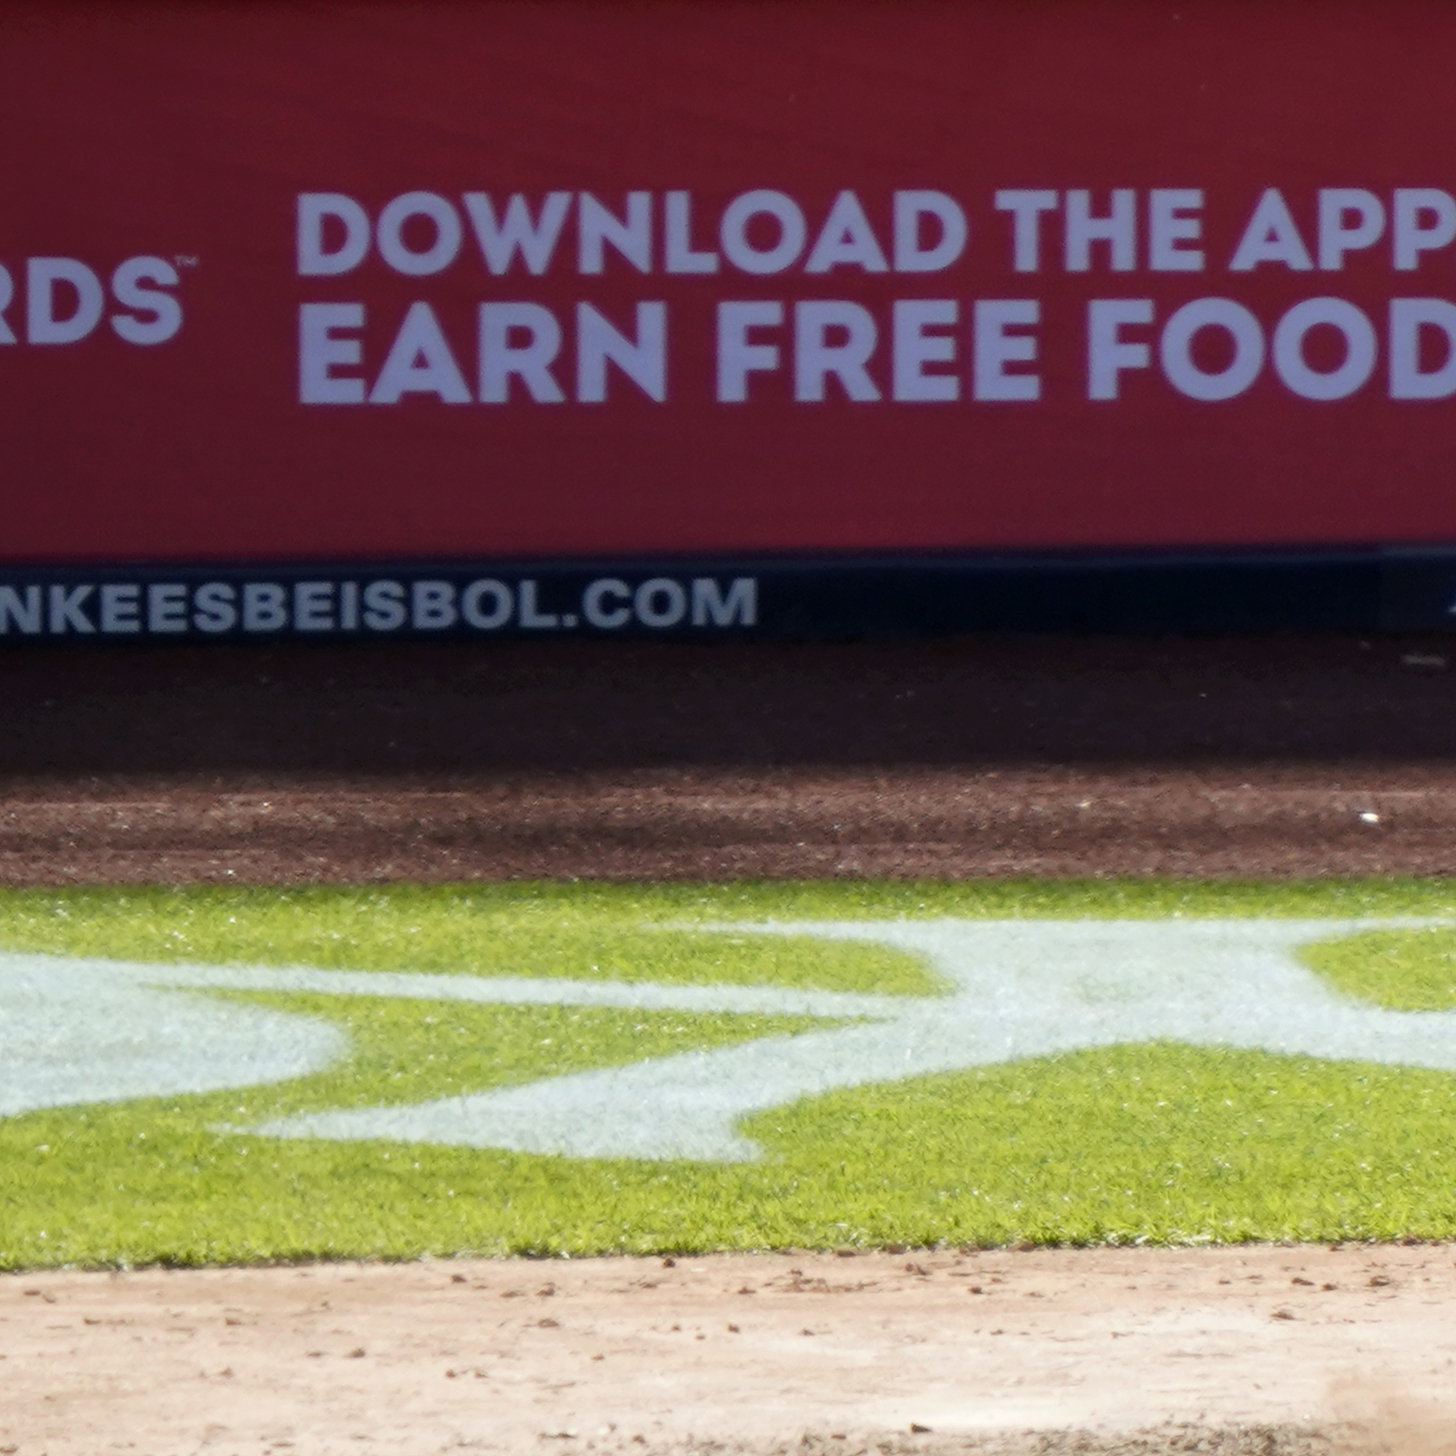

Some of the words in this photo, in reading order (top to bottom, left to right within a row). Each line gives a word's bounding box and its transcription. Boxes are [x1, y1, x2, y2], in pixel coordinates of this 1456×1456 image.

[297, 188, 969, 277] DOWNLOAD
[994, 187, 1206, 273] THE
[299, 300, 668, 405] EARN
[717, 298, 1042, 403] FREE
